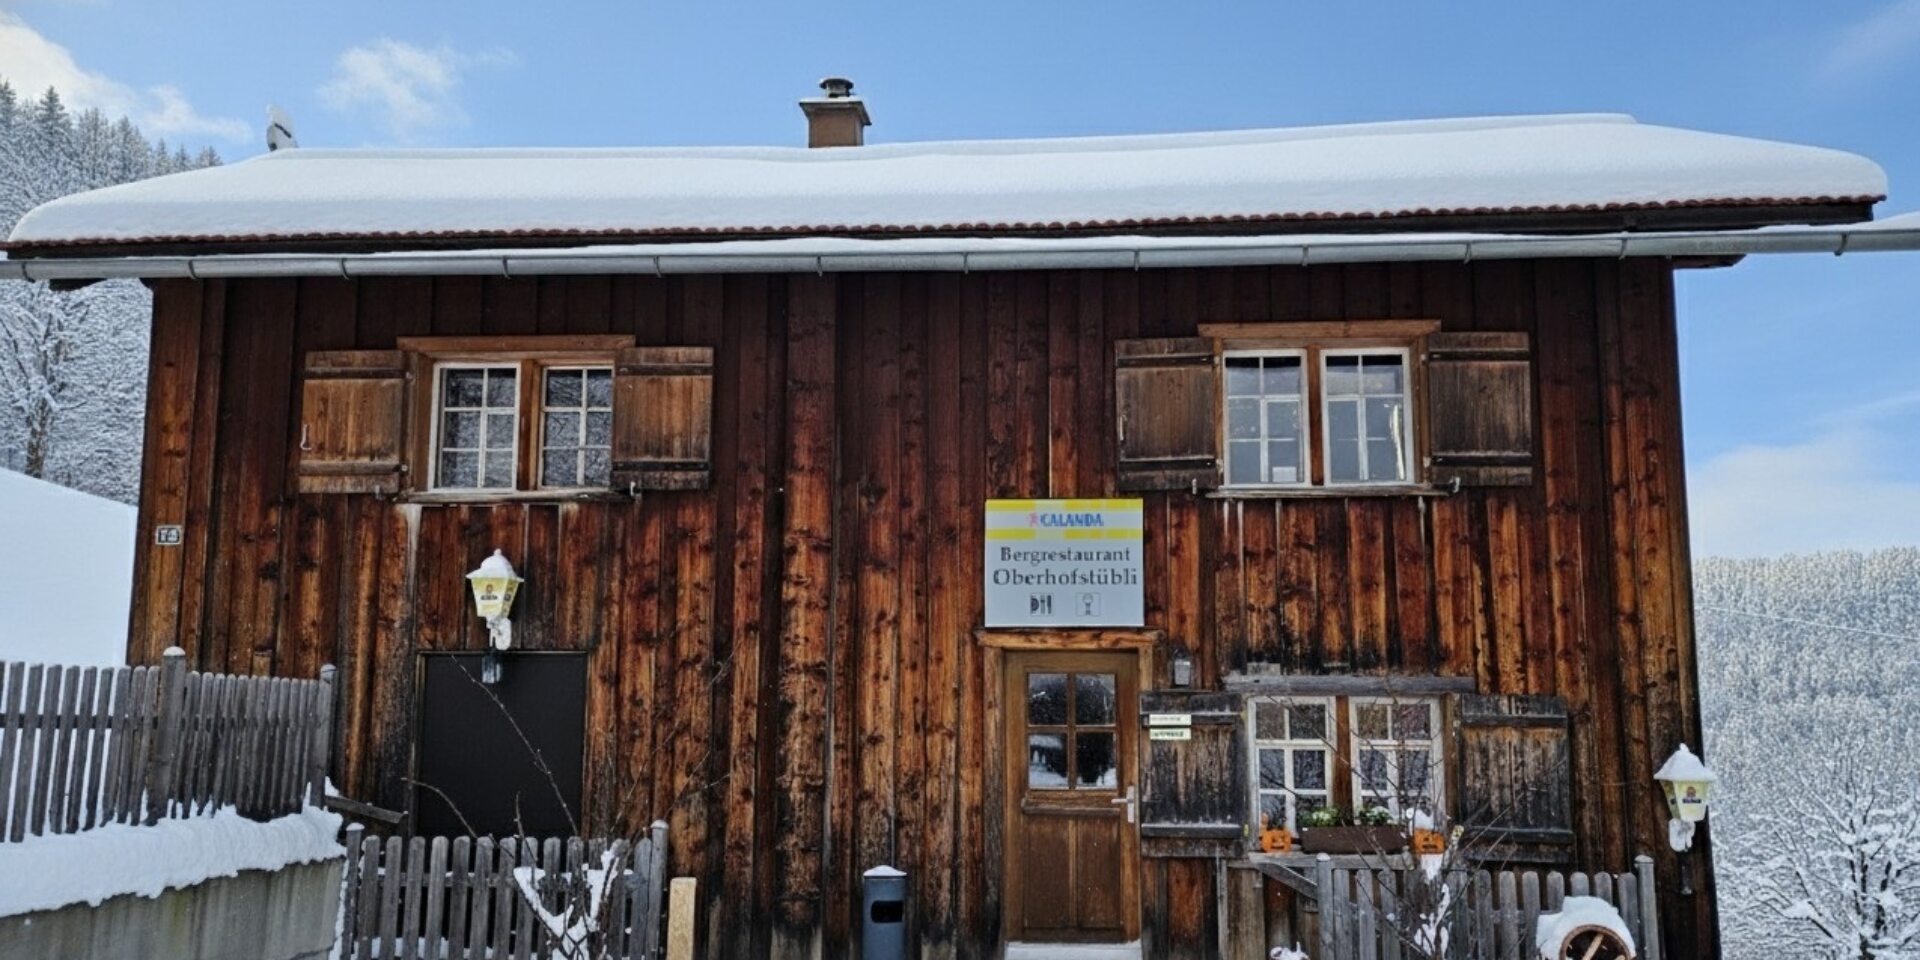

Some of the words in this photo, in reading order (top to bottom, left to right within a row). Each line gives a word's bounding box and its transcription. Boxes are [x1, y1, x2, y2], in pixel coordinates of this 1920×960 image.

[1040, 513, 1104, 527] CALANDA
[1000, 547, 1131, 566] Bergrestaurant
[993, 568, 1137, 586] Oberhofstübli
